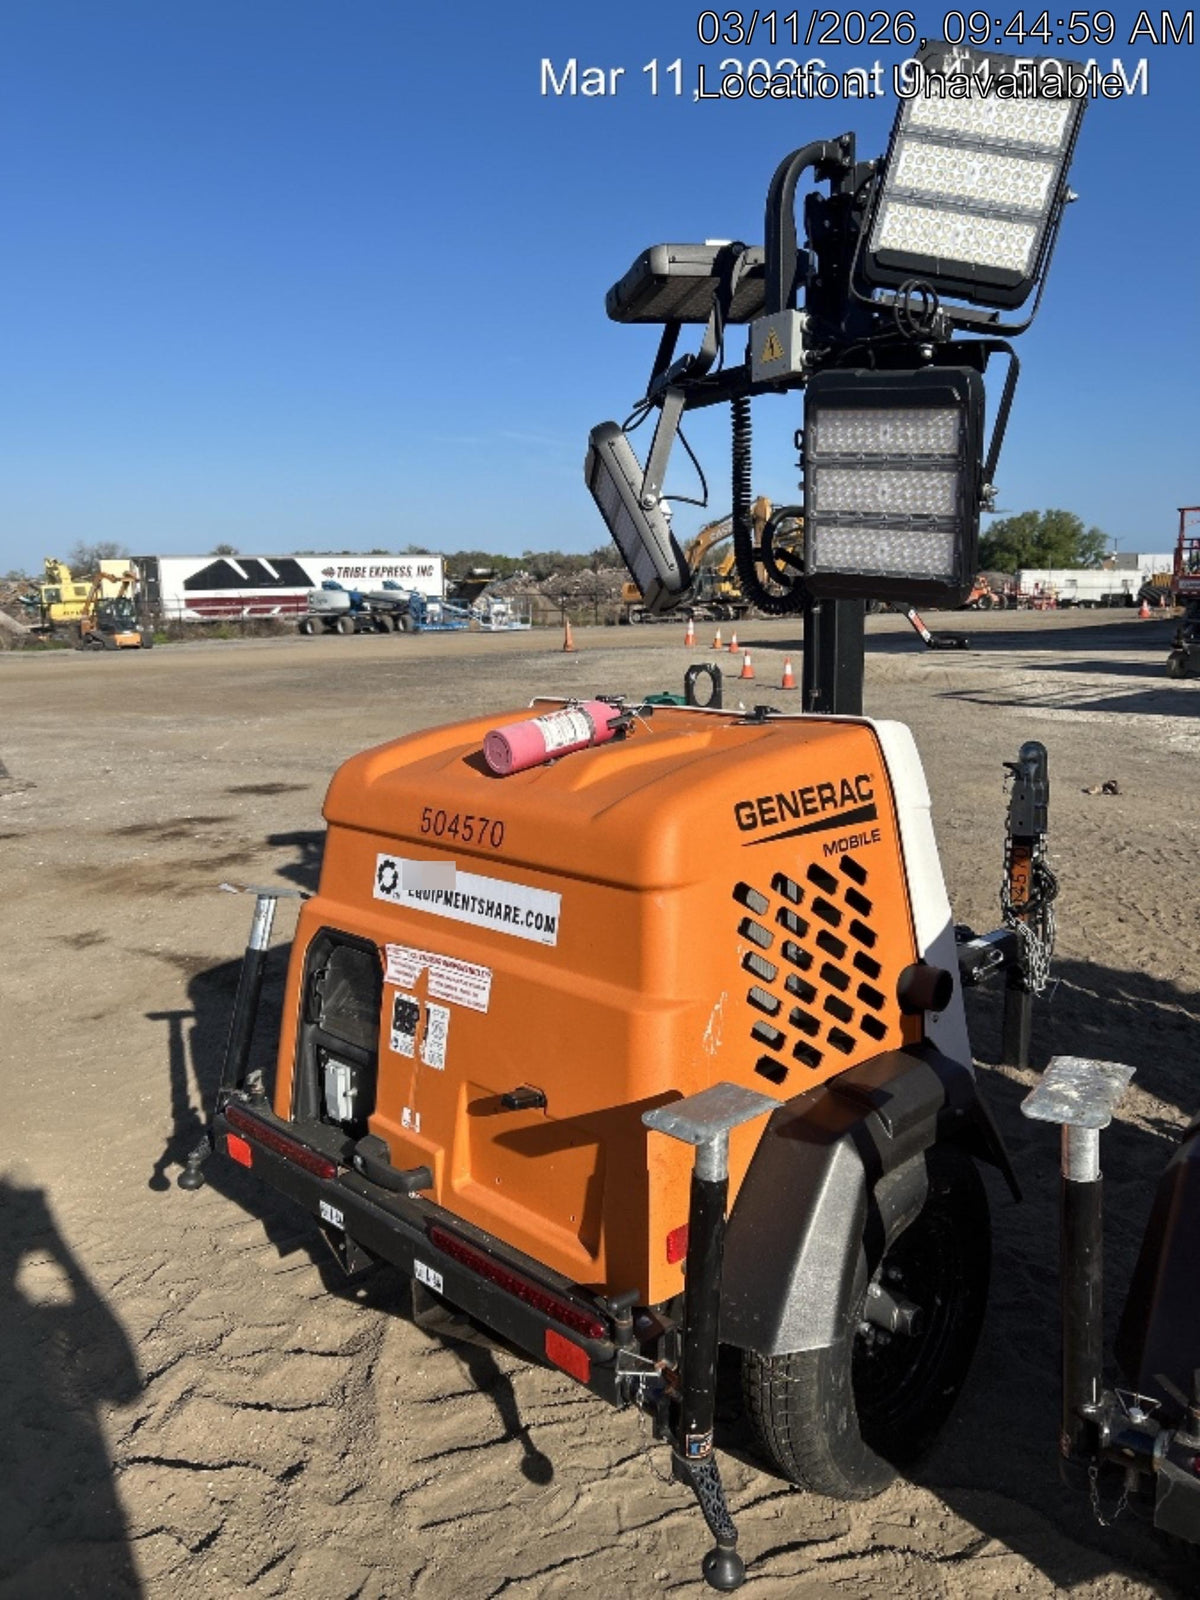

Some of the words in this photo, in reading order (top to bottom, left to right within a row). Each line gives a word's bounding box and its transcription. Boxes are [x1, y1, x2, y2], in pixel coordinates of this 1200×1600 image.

[337, 566, 367, 579] TRIBE
[416, 564, 435, 578] INC
[734, 774, 874, 831] GENERAC
[420, 806, 505, 849] 504570
[822, 828, 881, 857] MOBILE
